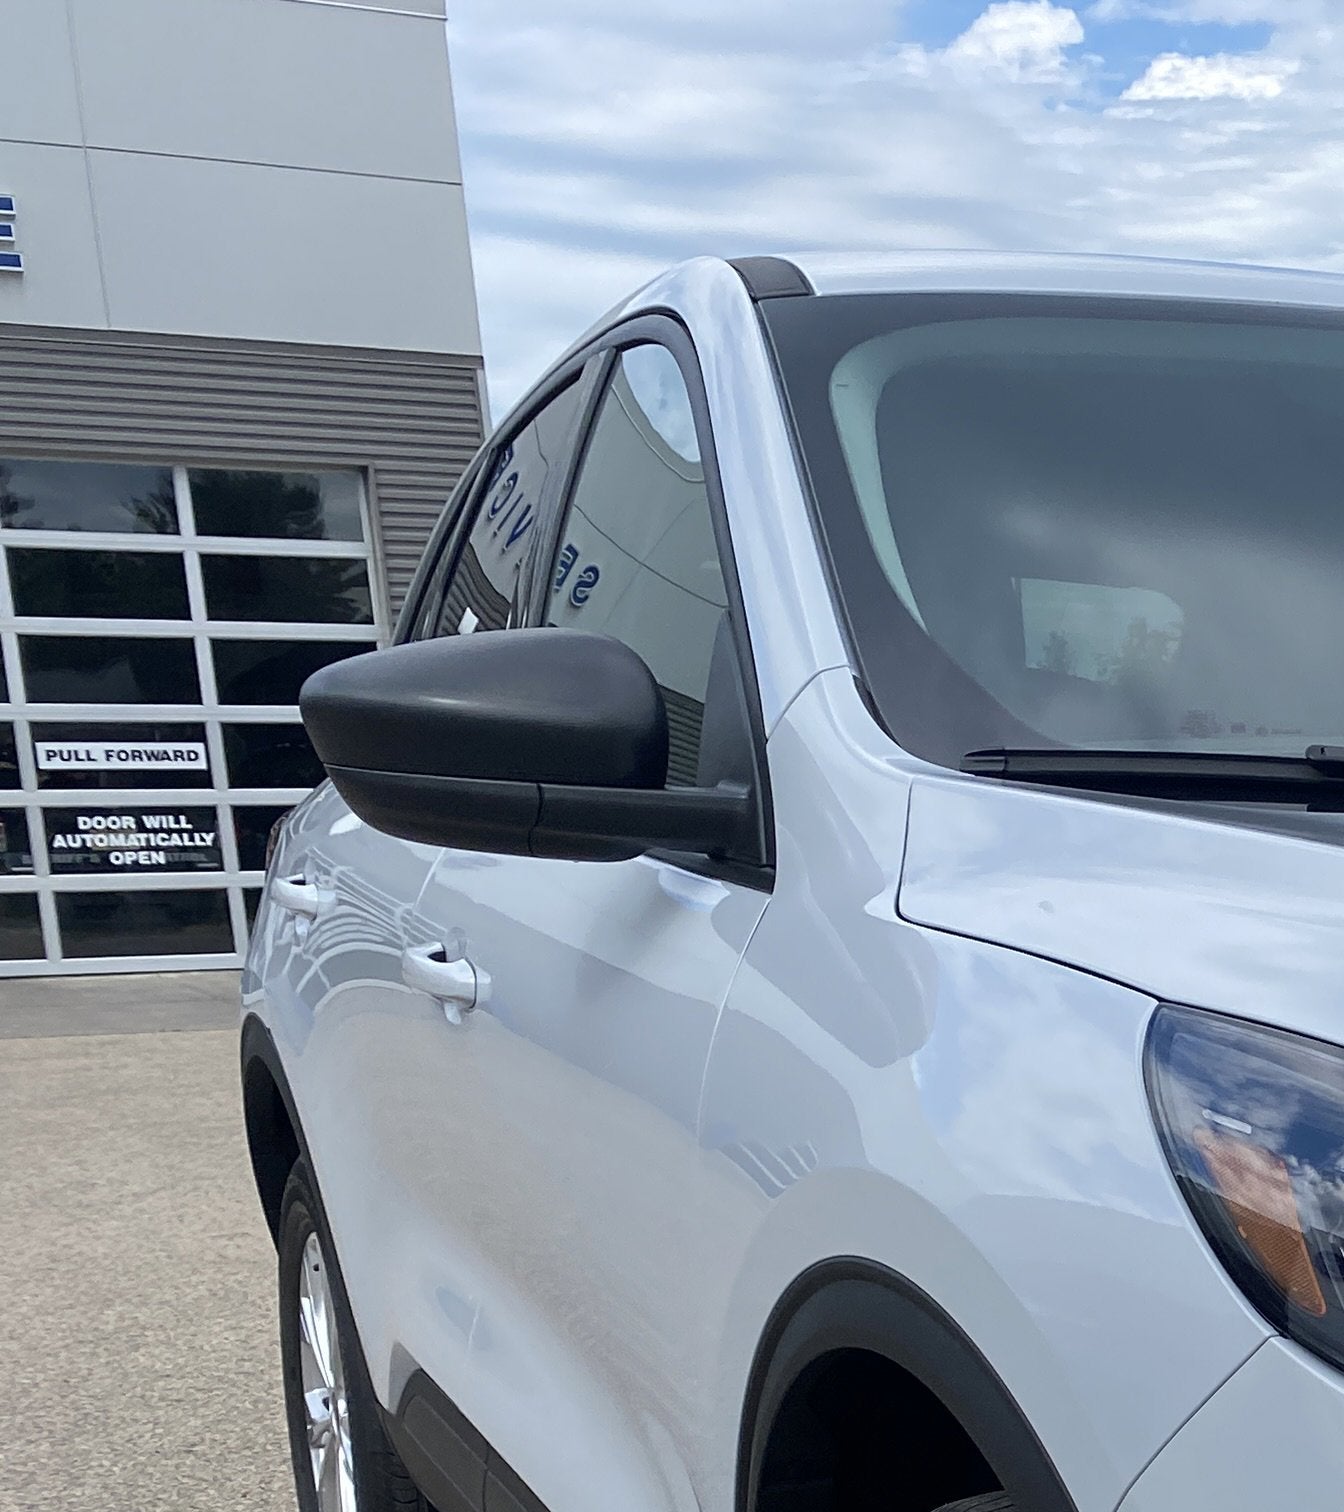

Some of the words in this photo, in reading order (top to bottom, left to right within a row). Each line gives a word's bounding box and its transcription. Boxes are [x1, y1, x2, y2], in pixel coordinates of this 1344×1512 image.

[45, 749, 98, 762] PULL
[105, 749, 199, 762] FORWARD
[77, 815, 136, 830] DOOR
[141, 814, 193, 829] WILL
[52, 832, 215, 849] AUTOMATICALLY
[109, 851, 166, 865] OPEN
